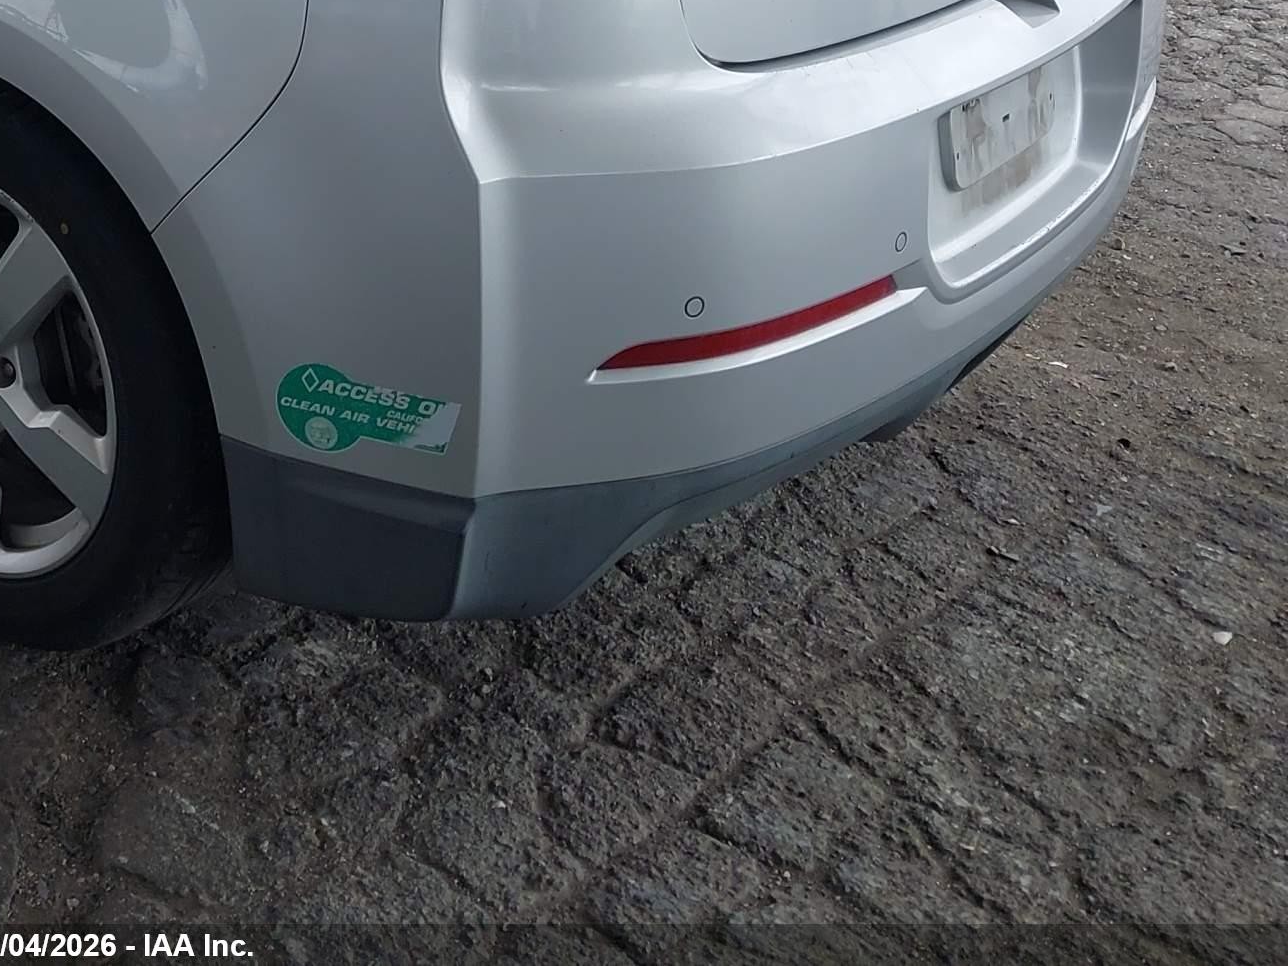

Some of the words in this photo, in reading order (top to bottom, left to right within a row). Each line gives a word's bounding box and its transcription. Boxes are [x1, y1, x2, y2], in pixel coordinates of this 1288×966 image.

[317, 379, 410, 410] ACCESS
[280, 396, 336, 416] CLEAN
[339, 410, 371, 424] AIR
